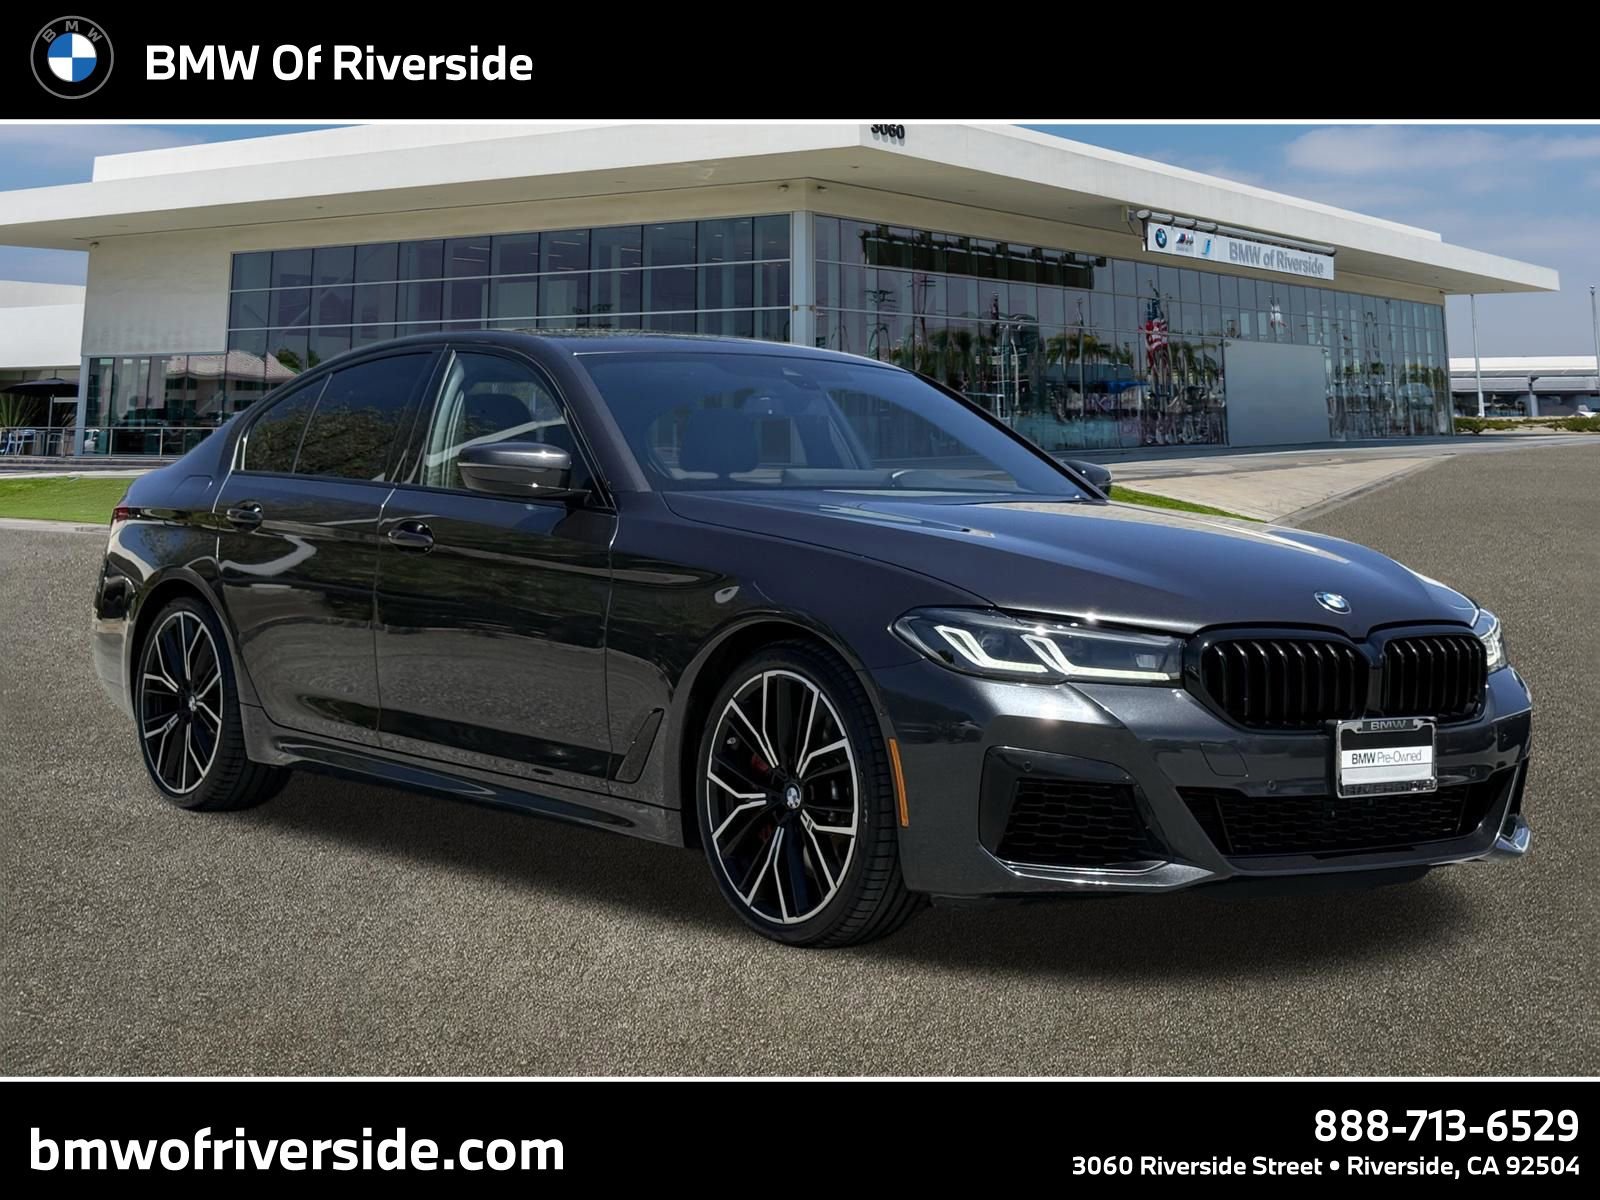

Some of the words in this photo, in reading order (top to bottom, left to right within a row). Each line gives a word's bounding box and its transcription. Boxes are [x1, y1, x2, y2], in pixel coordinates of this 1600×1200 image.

[1229, 241, 1261, 265] BMW
[1263, 249, 1275, 268] of
[1276, 250, 1324, 275] Riverside
[1371, 719, 1406, 730] BMW
[1352, 752, 1376, 765] BMW
[1377, 749, 1422, 764] Pre-Owned
